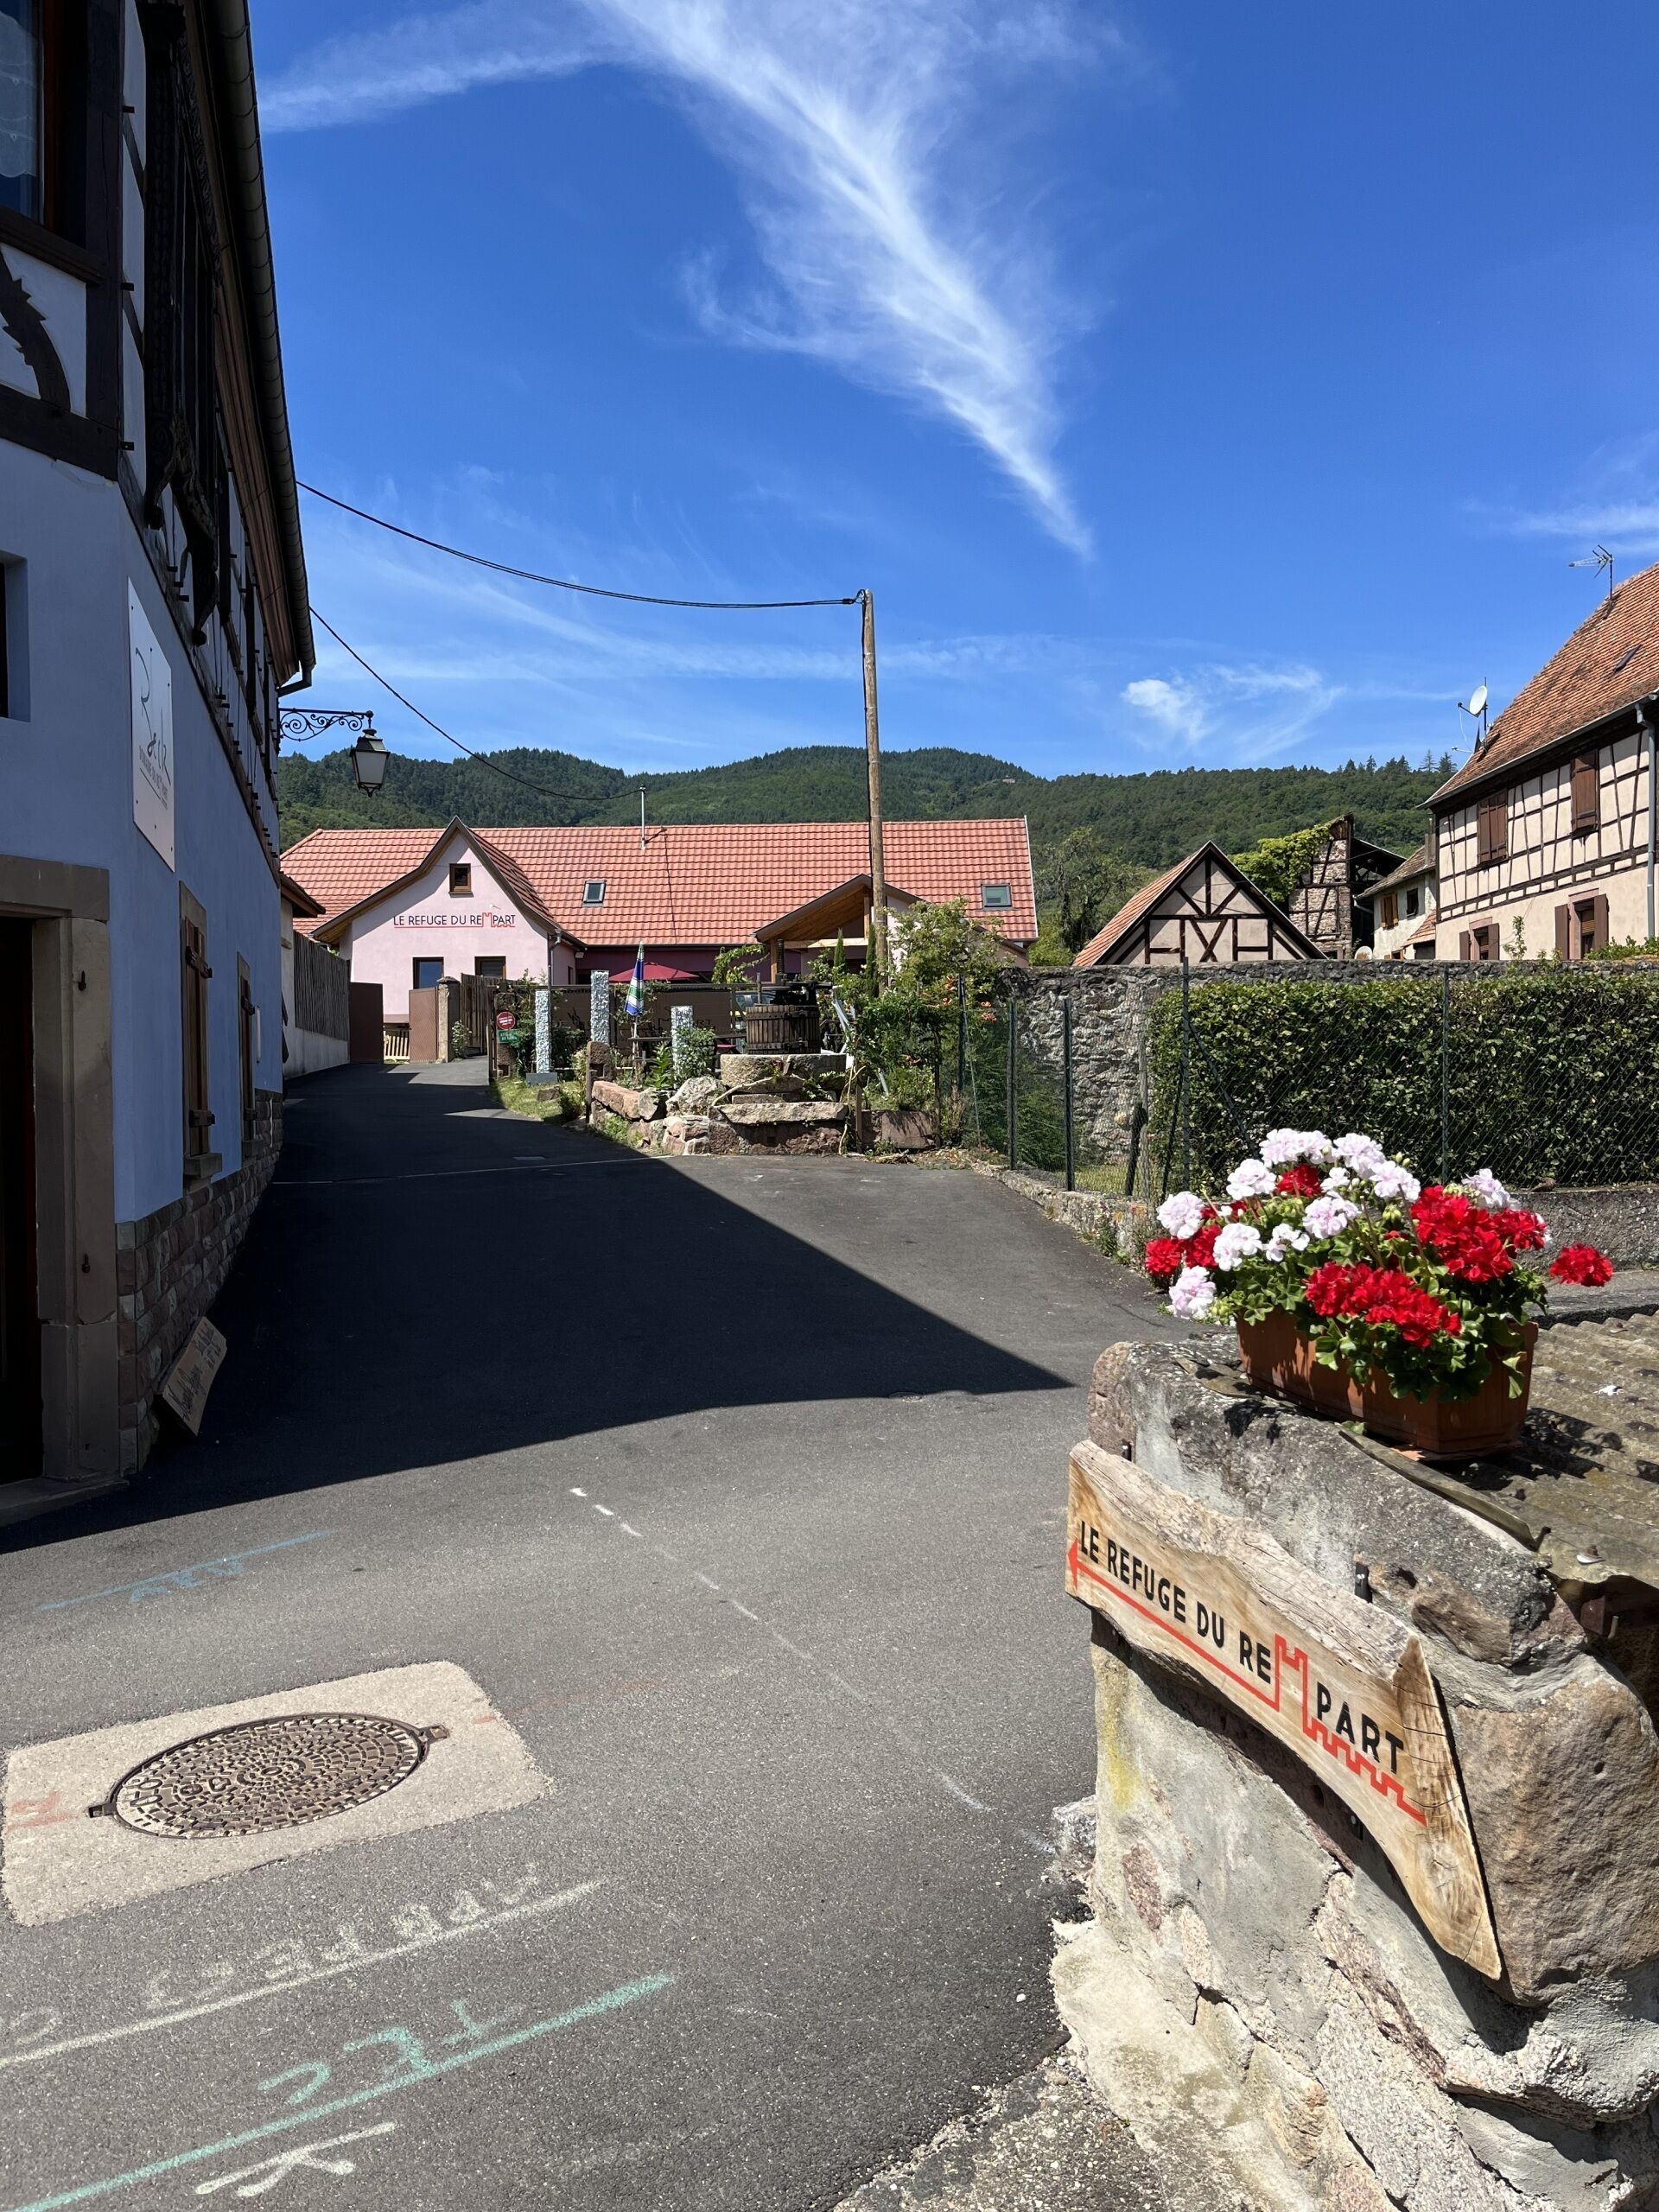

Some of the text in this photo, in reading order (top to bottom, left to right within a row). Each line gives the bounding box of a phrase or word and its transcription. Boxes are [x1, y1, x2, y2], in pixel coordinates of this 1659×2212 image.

[393, 915, 405, 925] LE
[408, 915, 448, 925] REFUGE
[451, 915, 467, 925] DU
[1079, 1519, 1099, 1565] LE
[1107, 1541, 1186, 1624] REFUGE
[1196, 1603, 1225, 1649] DU
